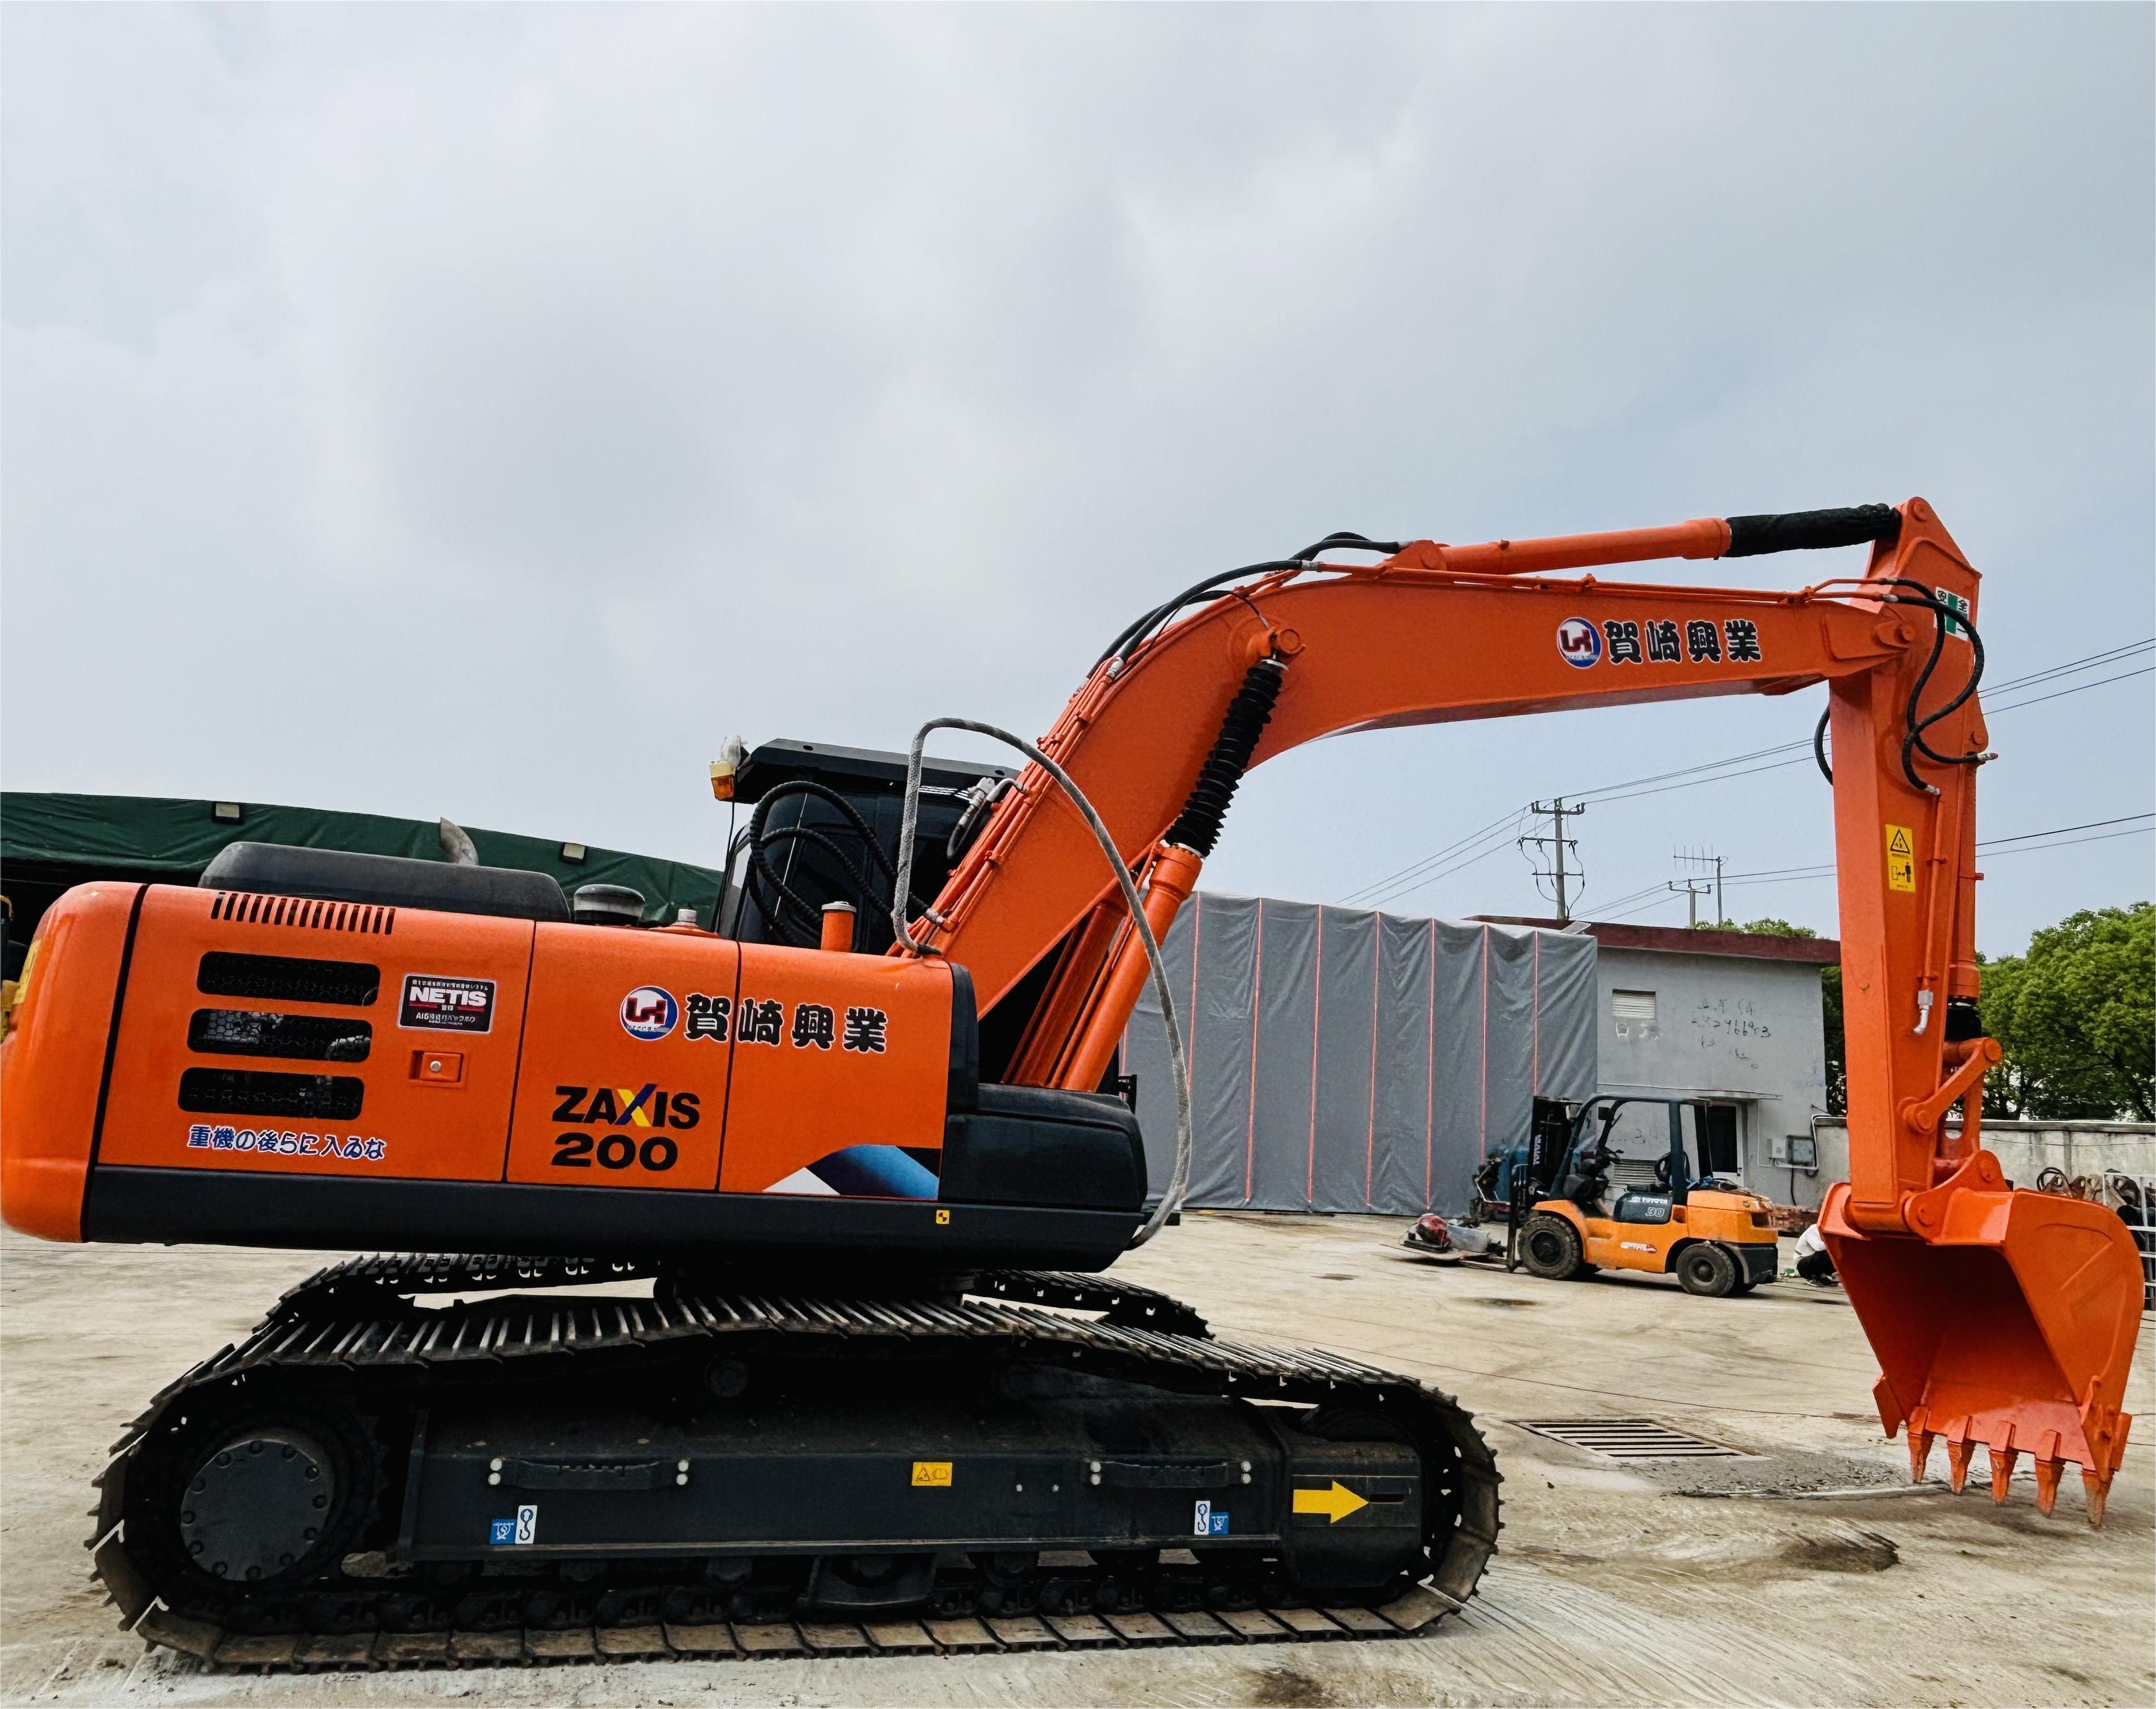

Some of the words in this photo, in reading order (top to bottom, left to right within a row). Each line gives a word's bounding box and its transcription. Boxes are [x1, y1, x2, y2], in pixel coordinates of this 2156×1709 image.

[410, 986, 487, 1007] NETIS
[552, 1083, 700, 1129] ZAXIS
[551, 1132, 678, 1171] 200
